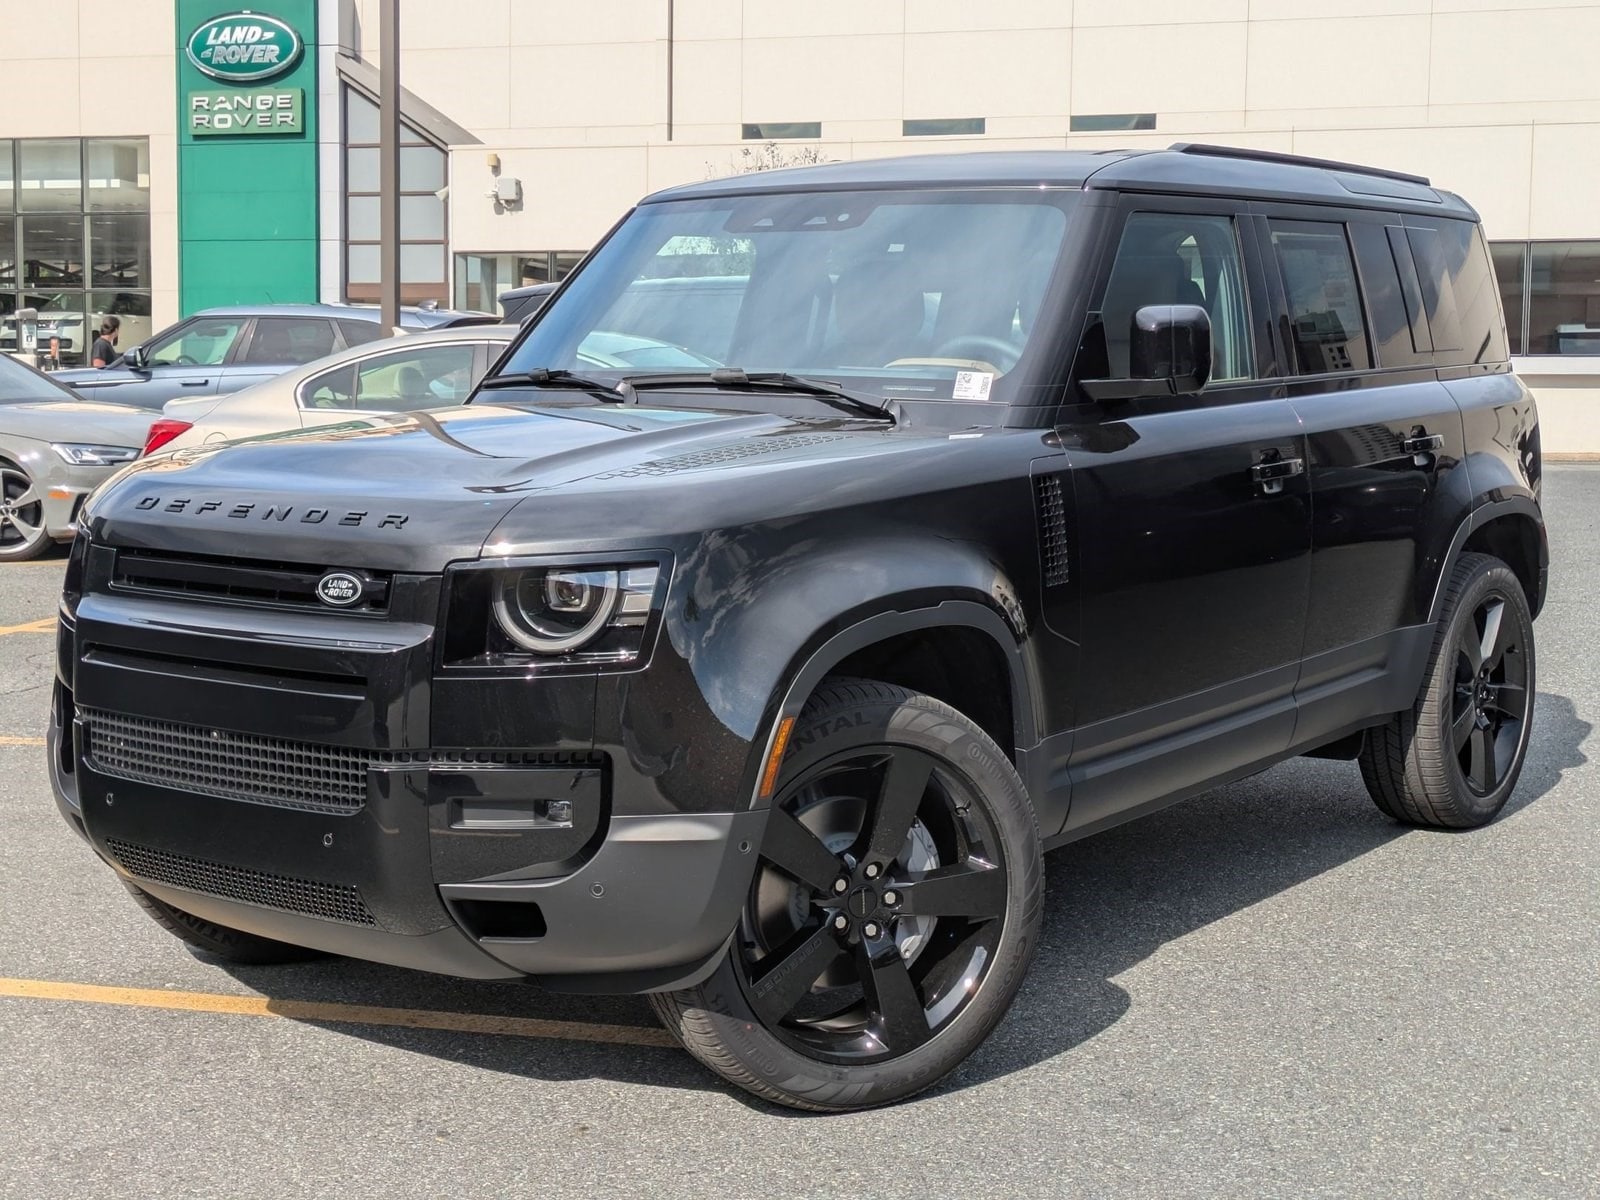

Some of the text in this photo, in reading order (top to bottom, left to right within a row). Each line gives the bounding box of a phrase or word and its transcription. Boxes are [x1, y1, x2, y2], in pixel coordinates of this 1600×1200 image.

[206, 26, 262, 45] LAND
[211, 45, 280, 64] ROVER
[192, 95, 293, 111] RANGE
[193, 112, 296, 129] ROVER
[135, 497, 409, 530] DEFENDER
[327, 579, 348, 589] LAND
[327, 588, 353, 598] ROVER
